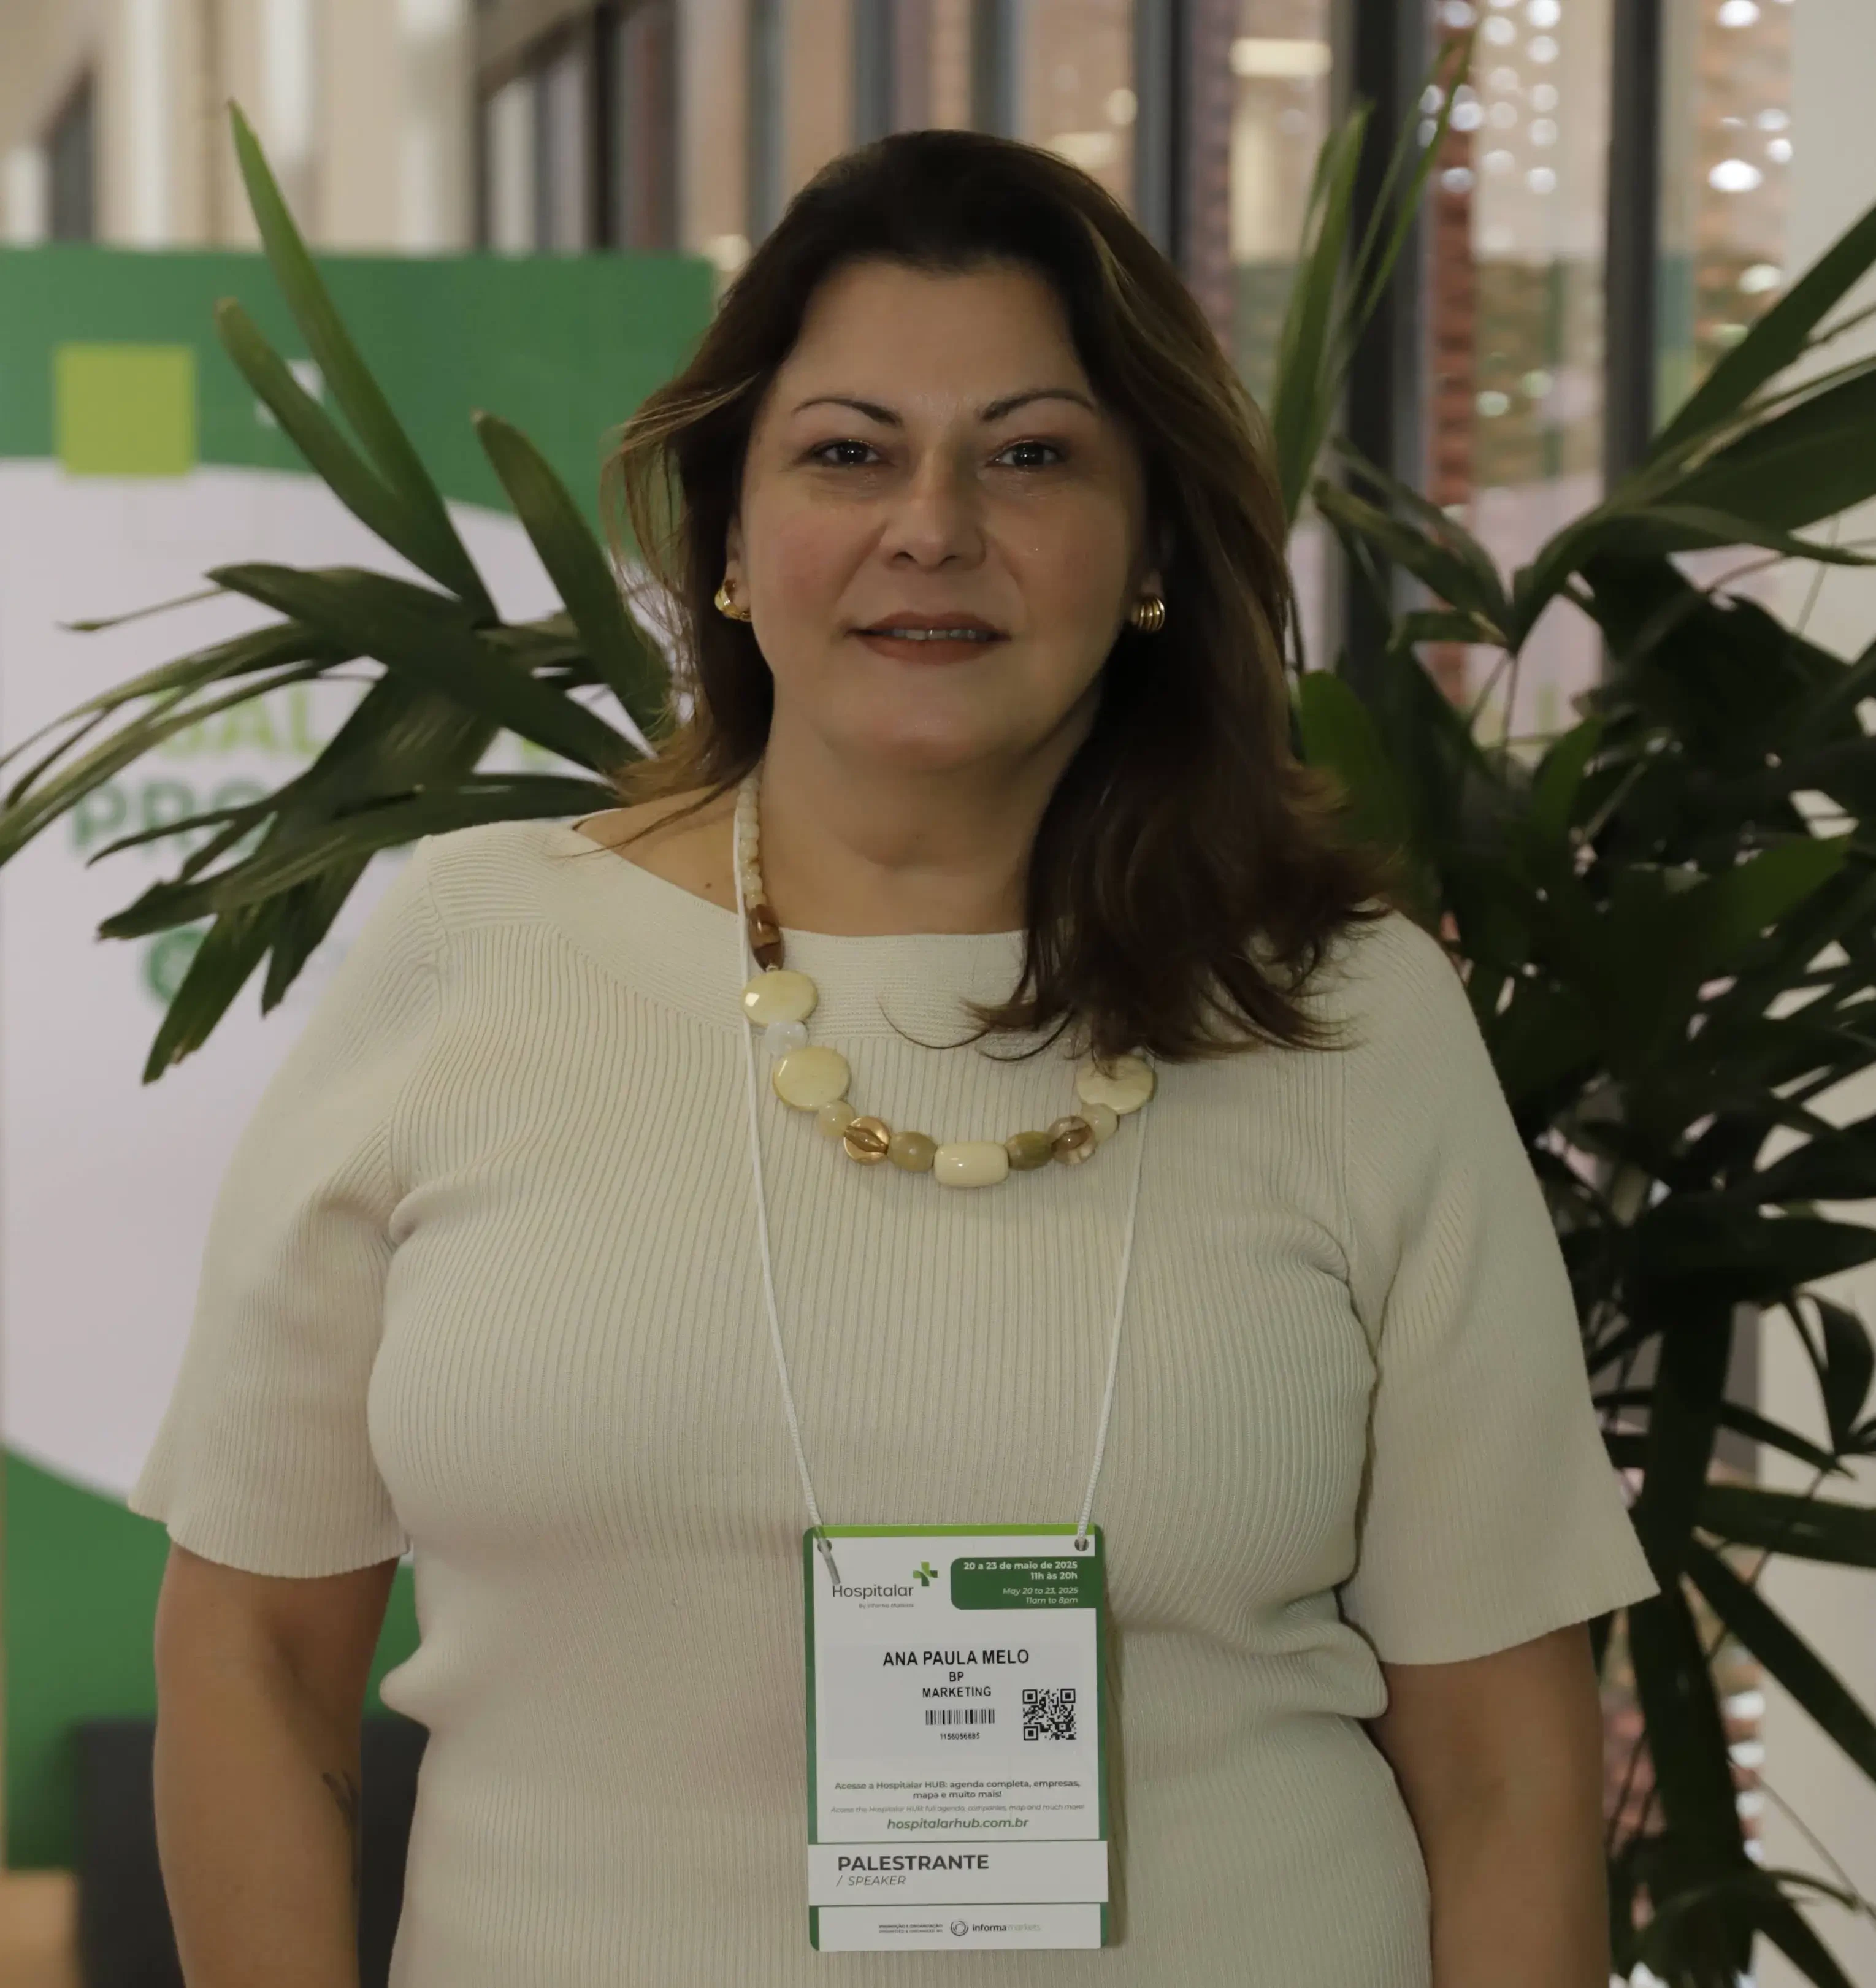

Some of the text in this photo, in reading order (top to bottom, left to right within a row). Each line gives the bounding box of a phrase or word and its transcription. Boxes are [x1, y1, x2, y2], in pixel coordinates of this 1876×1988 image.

[1040, 1561, 1053, 1569] de
[1055, 1561, 1078, 1569] 2025
[1046, 1571, 1057, 1580] às
[832, 1584, 914, 1599] Hospitalar
[1003, 1588, 1020, 1596] May
[883, 1649, 1030, 1666] ANA PAULA MELO
[949, 1672, 964, 1682] BP
[922, 1686, 992, 1698] MARKETING
[876, 1781, 922, 1790] Hospitalar
[949, 1781, 984, 1790] agenda
[986, 1780, 1032, 1789] completa,
[1033, 1781, 1080, 1789] empresas,
[978, 1790, 1002, 1799] mais!
[887, 1818, 1028, 1831] hospitalarhub.com.br
[838, 1854, 989, 1871] PALESTRANTE
[848, 1875, 906, 1886] SPEAKER
